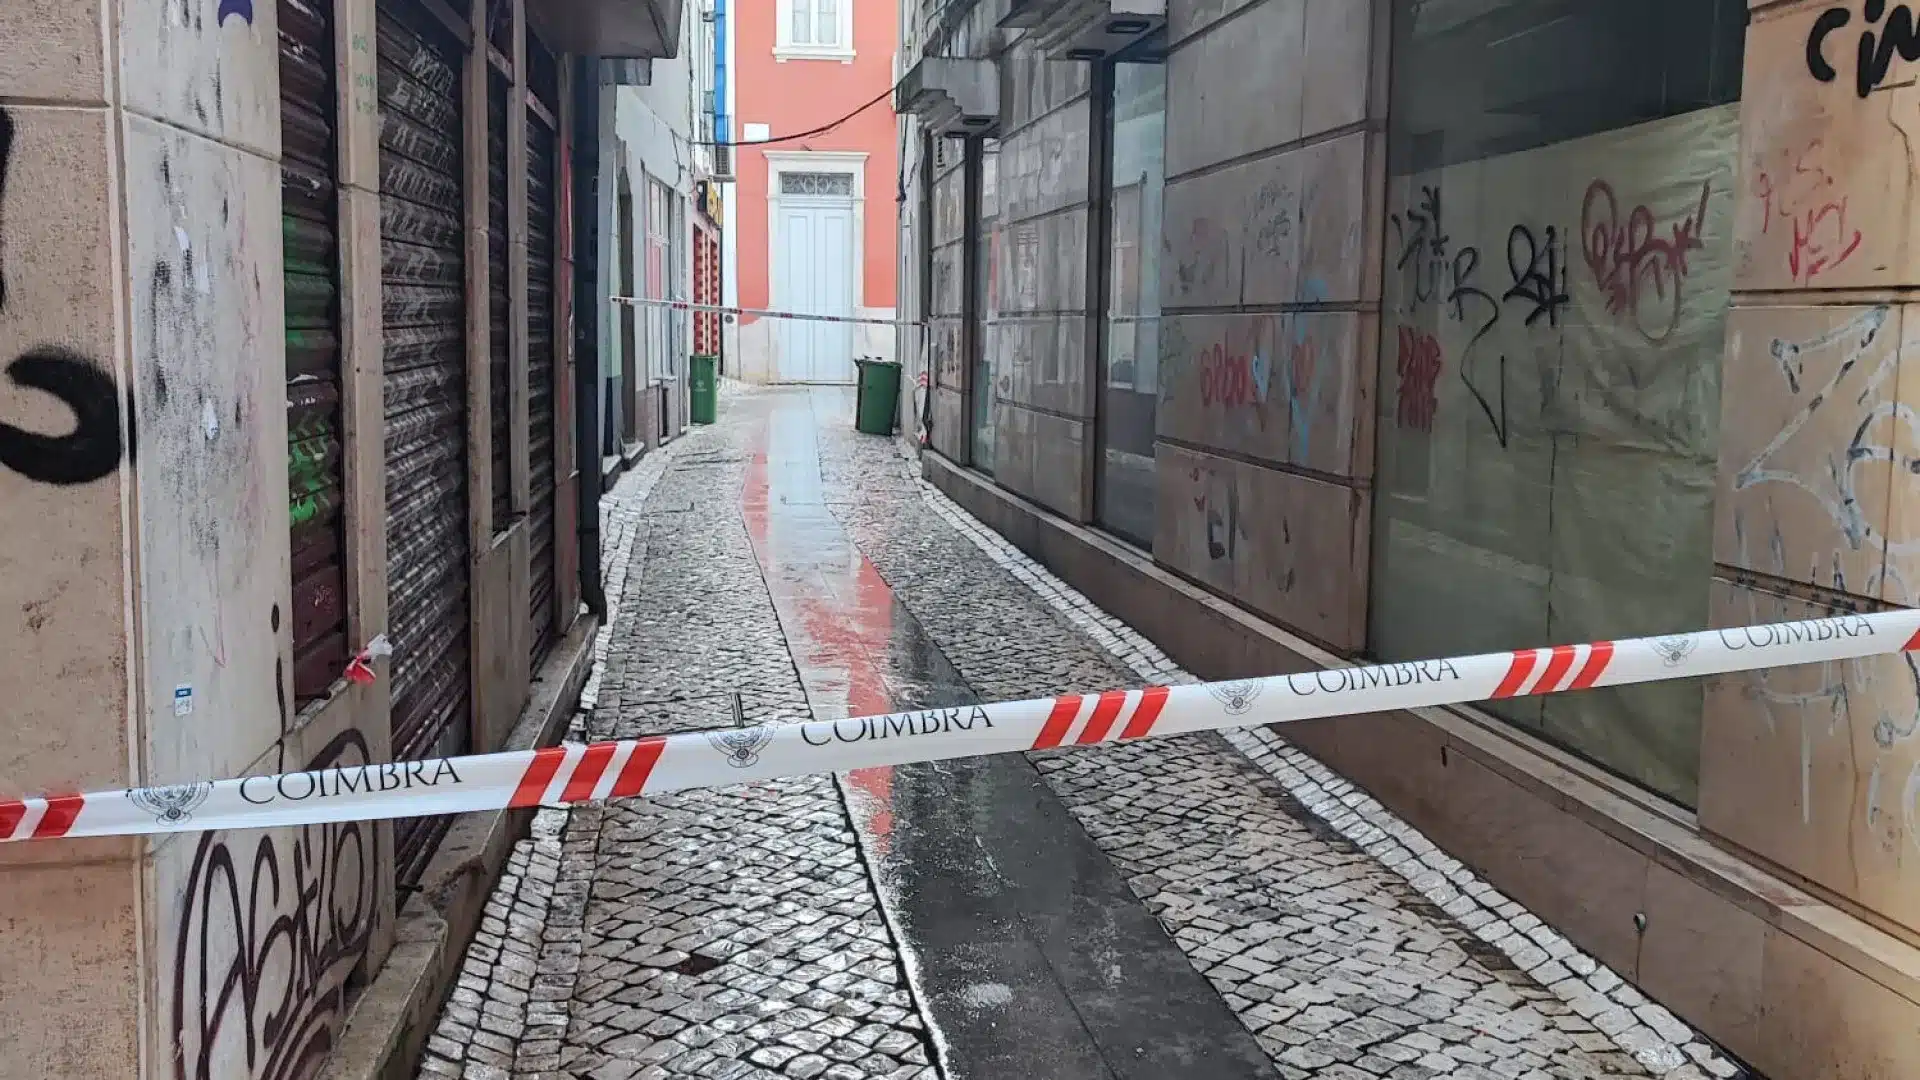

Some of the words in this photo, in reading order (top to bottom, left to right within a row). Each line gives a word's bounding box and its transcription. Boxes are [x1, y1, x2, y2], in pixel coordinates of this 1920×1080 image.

[1719, 616, 1875, 651] COIMBRA
[1288, 656, 1462, 696] COIMBRA
[800, 705, 995, 746] COIMBRA
[239, 757, 463, 805] COIMBRA
